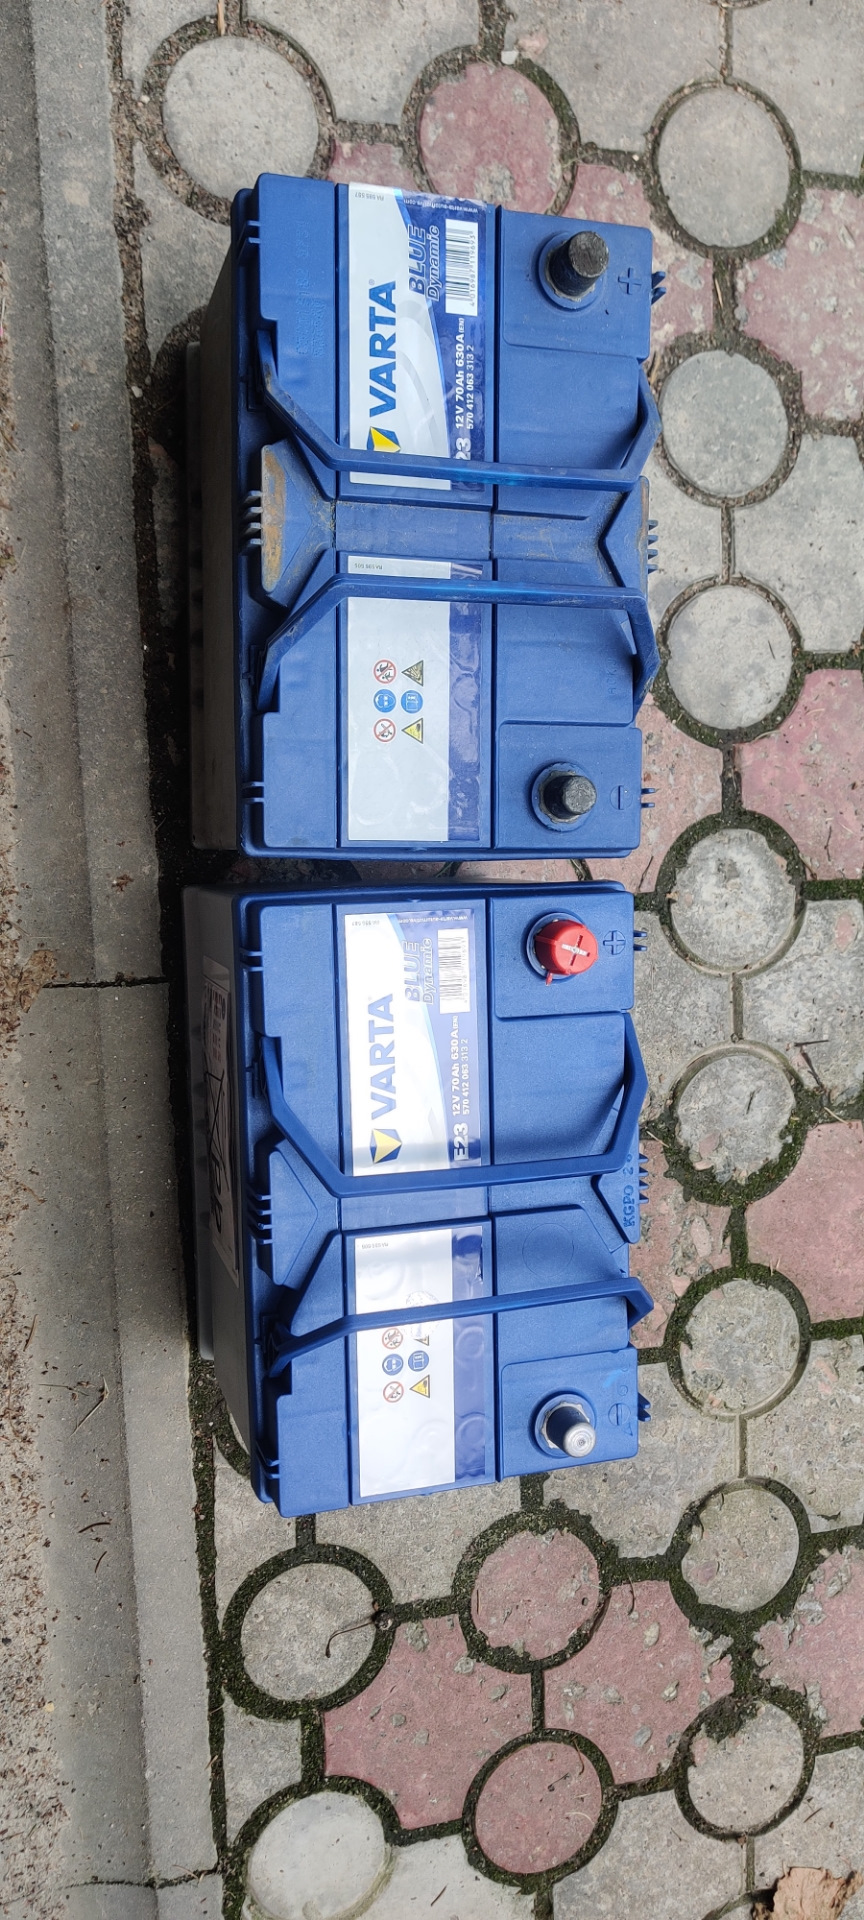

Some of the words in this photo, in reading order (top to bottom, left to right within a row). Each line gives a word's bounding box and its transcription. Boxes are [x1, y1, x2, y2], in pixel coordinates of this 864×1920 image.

[408, 224, 426, 295] BLUE
[427, 226, 442, 302] Dynamic
[368, 281, 396, 417] VARTA
[466, 353, 474, 371] 313
[455, 371, 464, 401] 70Ah
[466, 373, 474, 391] 063
[466, 392, 474, 410] 412
[455, 404, 464, 429] 12V
[466, 412, 474, 429] 570
[455, 437, 471, 460] 23
[401, 940, 421, 1002] BLUE
[421, 937, 437, 1005] Dynamic
[367, 993, 397, 1120] VARTA
[461, 1046, 469, 1062] 313
[451, 1063, 461, 1092] 70Ah
[462, 1080, 470, 1097] 412
[452, 1095, 461, 1116] 12V
[462, 1097, 470, 1115] 570
[453, 1122, 469, 1162] E23
